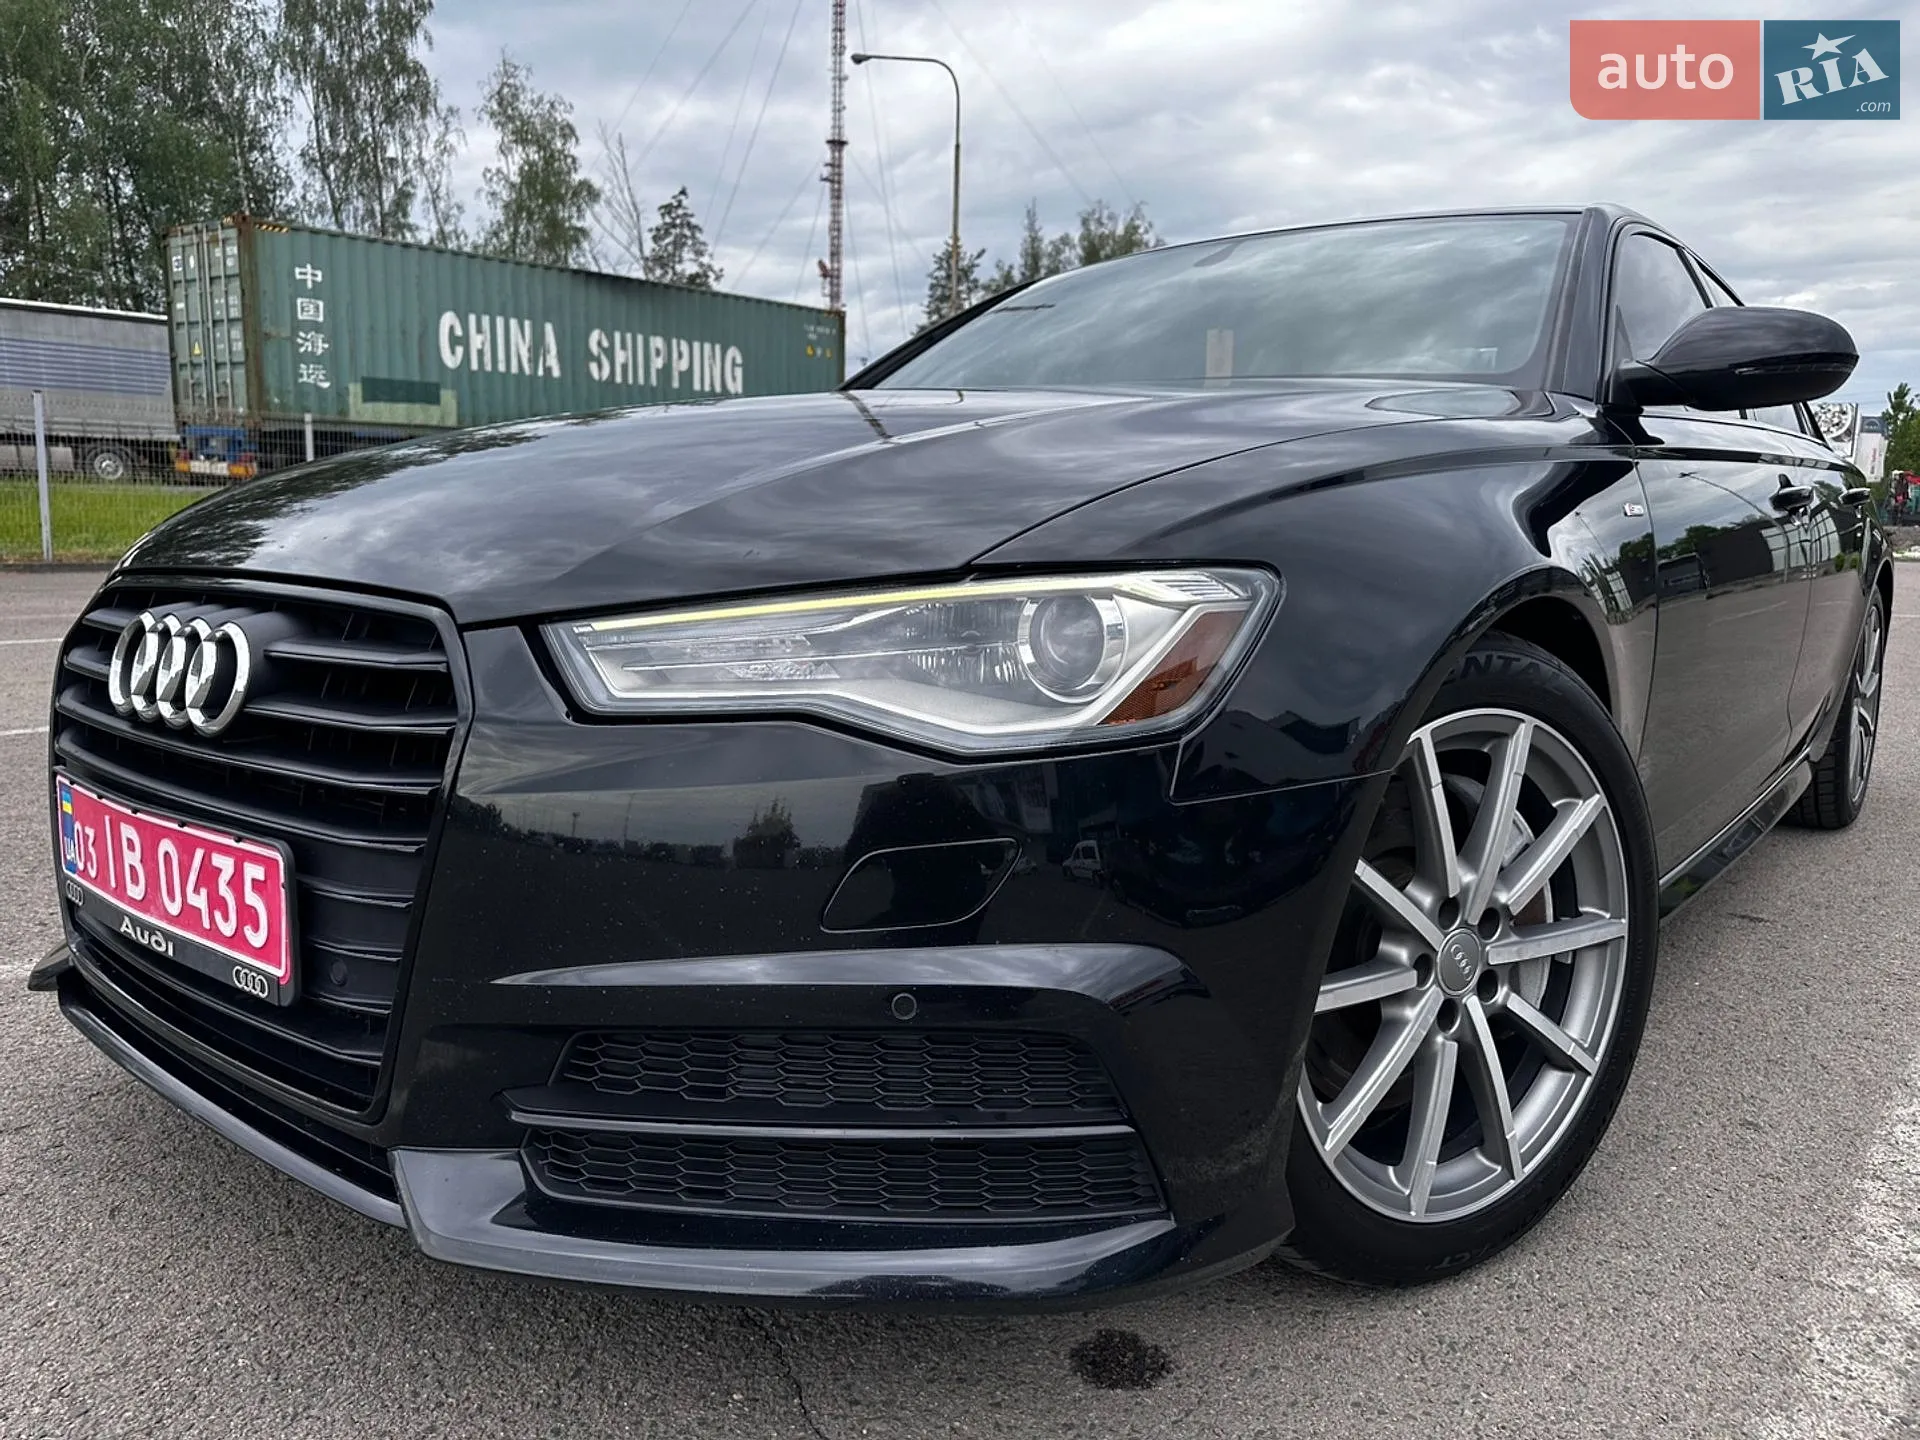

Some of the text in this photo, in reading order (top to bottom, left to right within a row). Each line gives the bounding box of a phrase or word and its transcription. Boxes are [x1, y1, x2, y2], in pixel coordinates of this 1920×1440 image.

[294, 263, 331, 389] 中国海运
[438, 310, 744, 395] CHINA SHIPPING
[74, 821, 97, 879] 03
[158, 838, 269, 949] 0435
[120, 916, 175, 957] Audi
